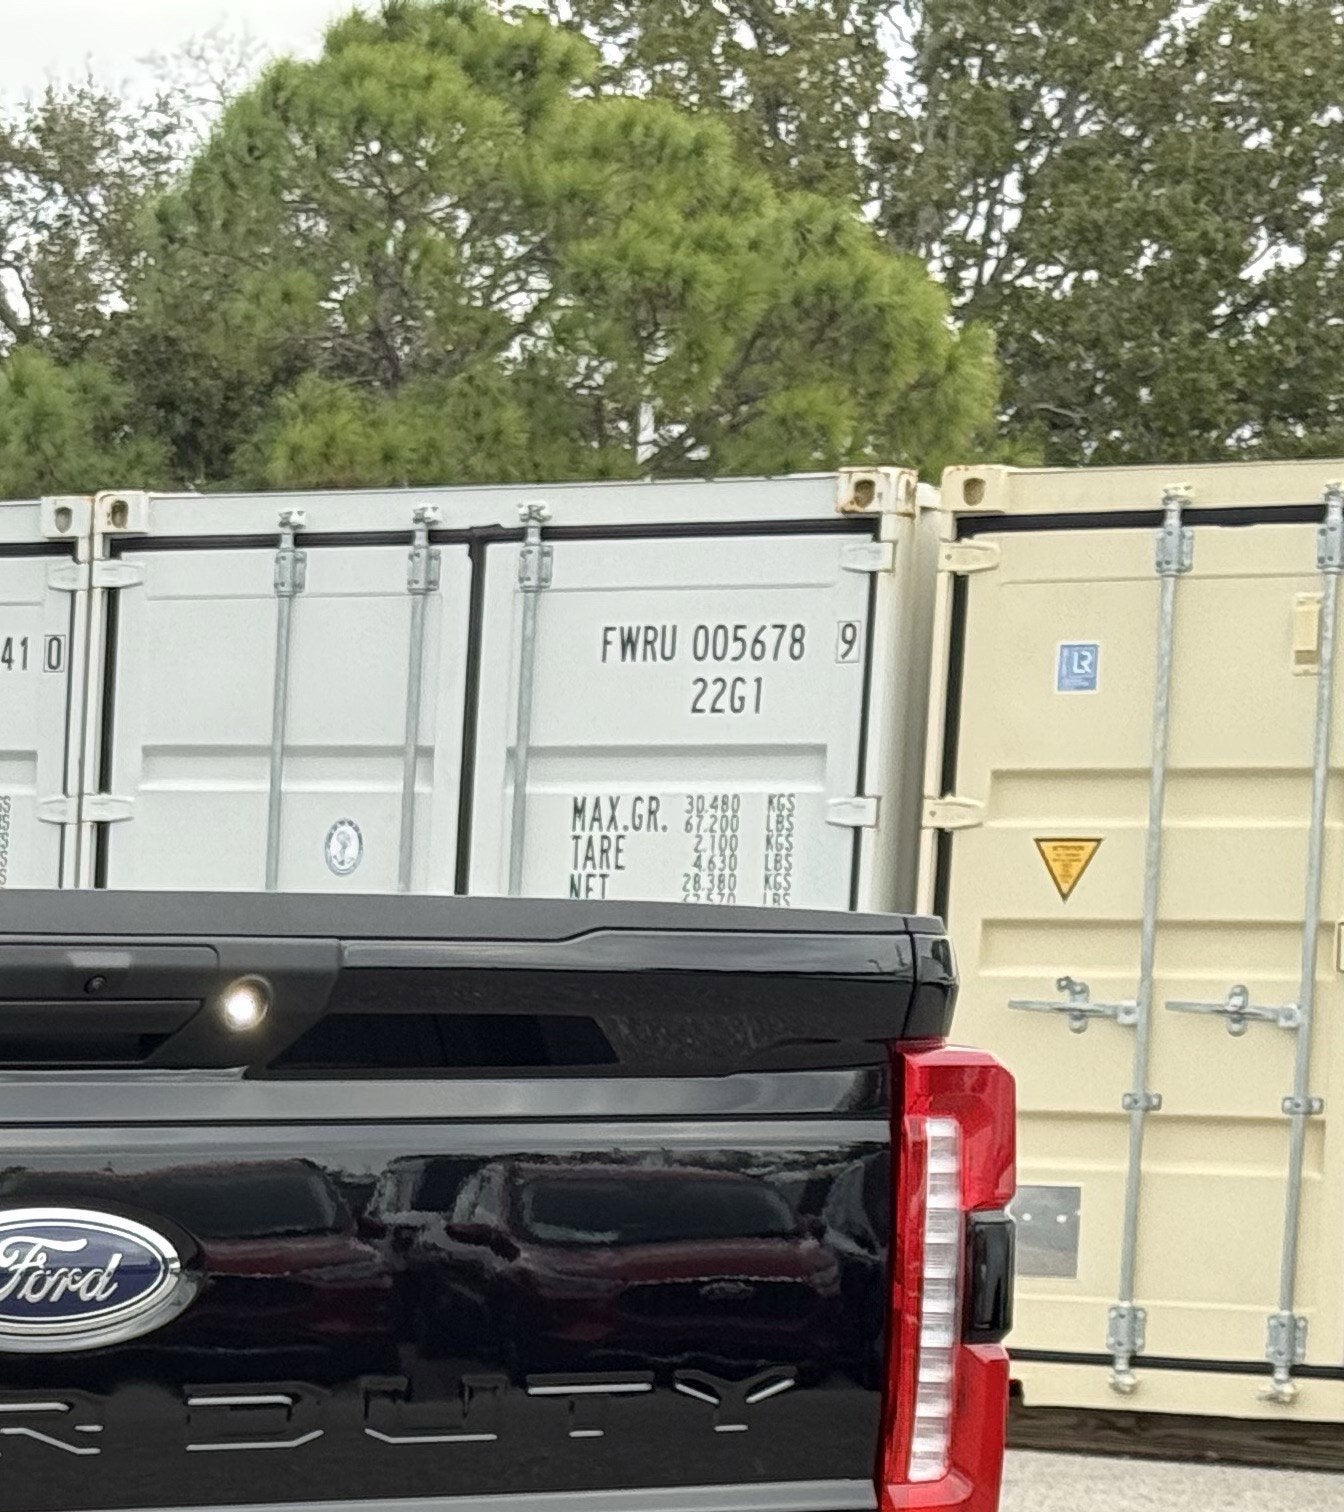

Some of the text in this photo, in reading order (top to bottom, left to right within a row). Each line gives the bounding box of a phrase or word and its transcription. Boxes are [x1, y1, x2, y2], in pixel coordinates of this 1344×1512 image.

[47, 636, 62, 670] 0
[601, 622, 858, 663] FWRU 005678 9
[691, 676, 763, 714] 22G1
[571, 793, 796, 832] MAX.GR. 30.480 KGS
[684, 813, 795, 833] 67.200 LBS
[571, 834, 794, 870] TARE 2.100 KGS
[692, 853, 793, 872] 4.630 LBS
[682, 873, 737, 892] 28.380
[764, 873, 792, 892] KGS
[185, 1378, 796, 1452] DUTY
